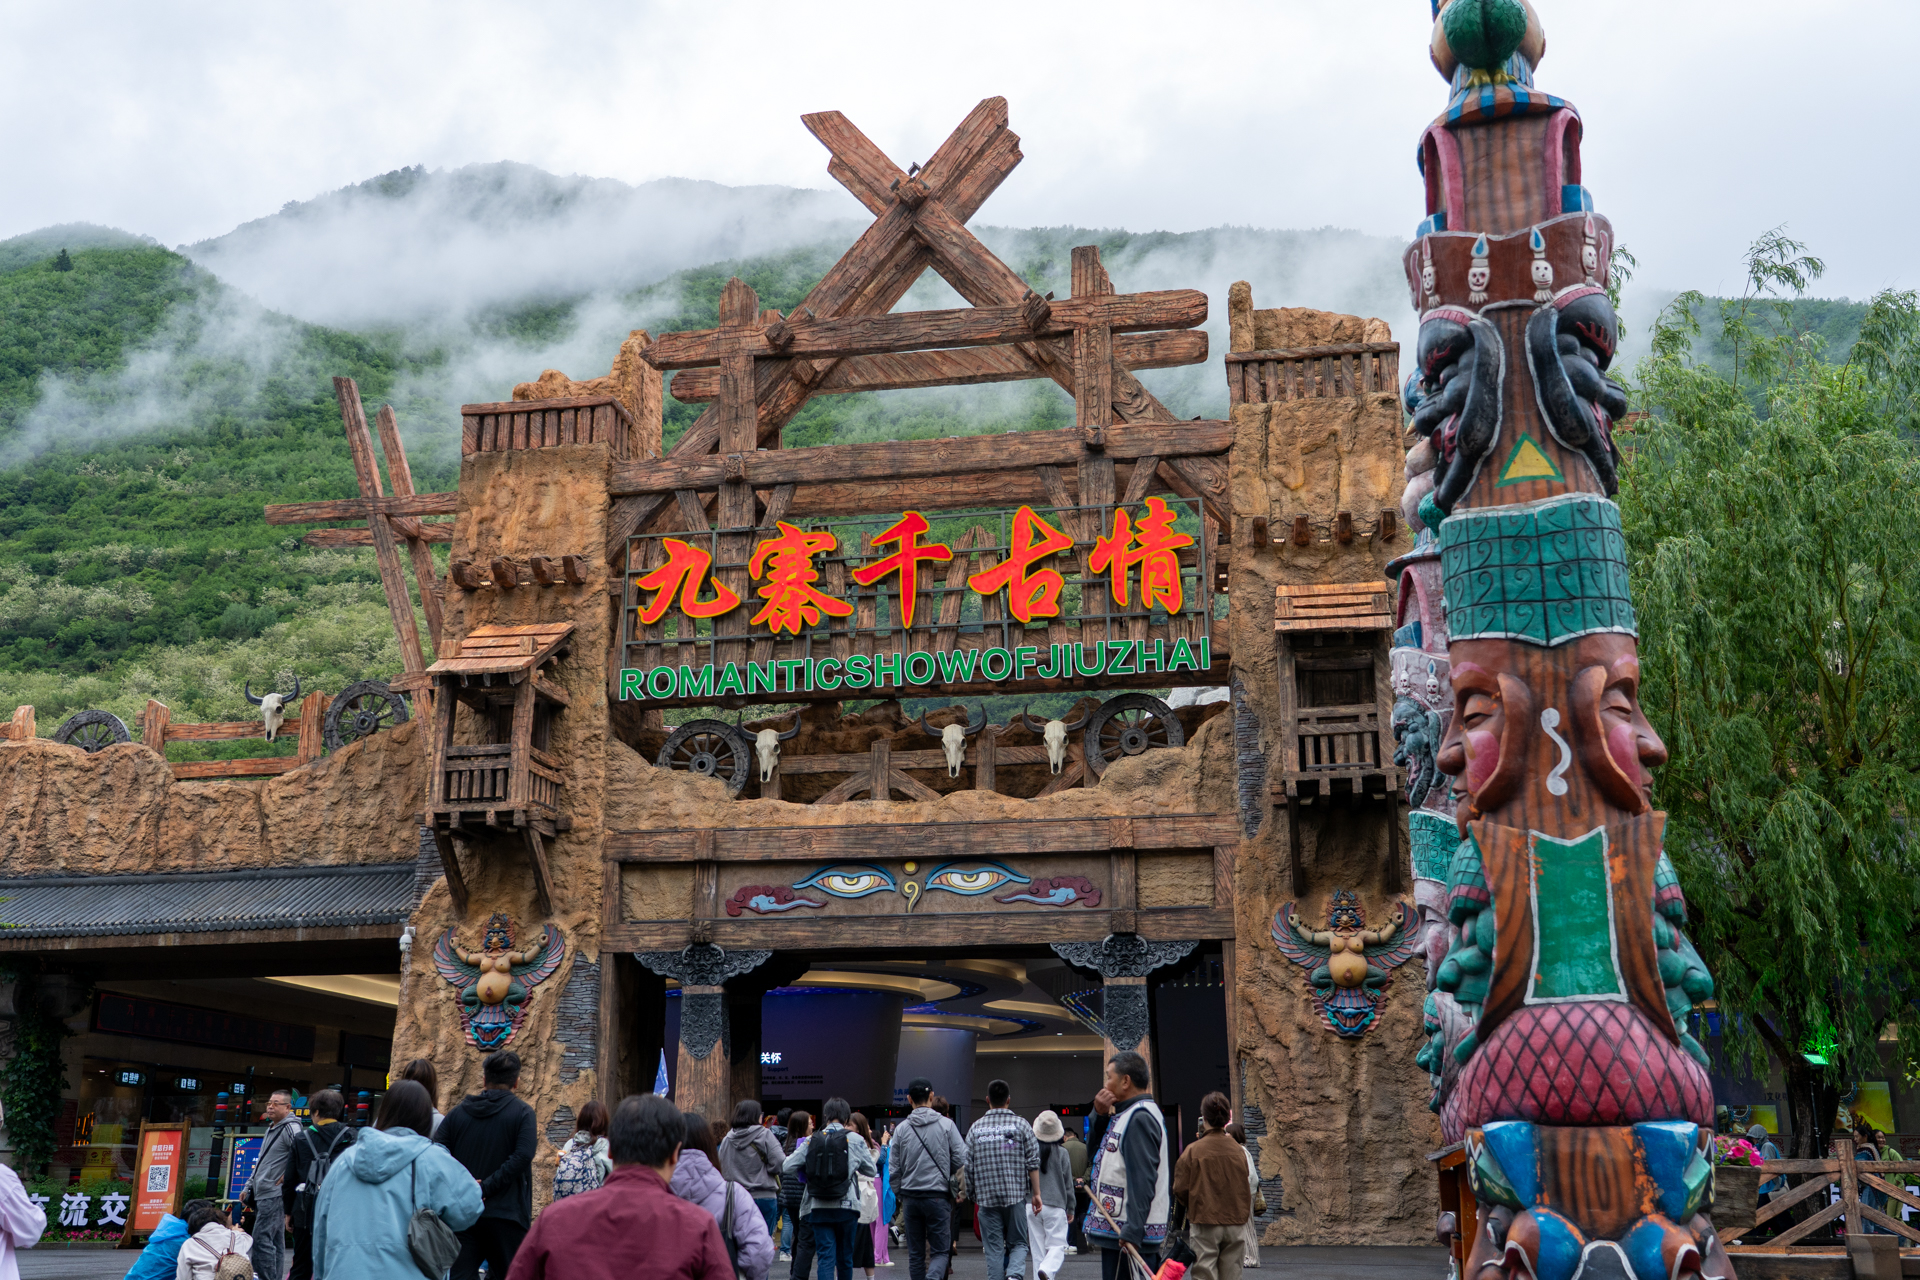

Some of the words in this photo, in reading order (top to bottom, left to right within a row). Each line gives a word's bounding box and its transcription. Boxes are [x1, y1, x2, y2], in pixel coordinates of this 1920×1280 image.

[635, 496, 1195, 636] 九寨千古情
[760, 1051, 782, 1065] 关怀
